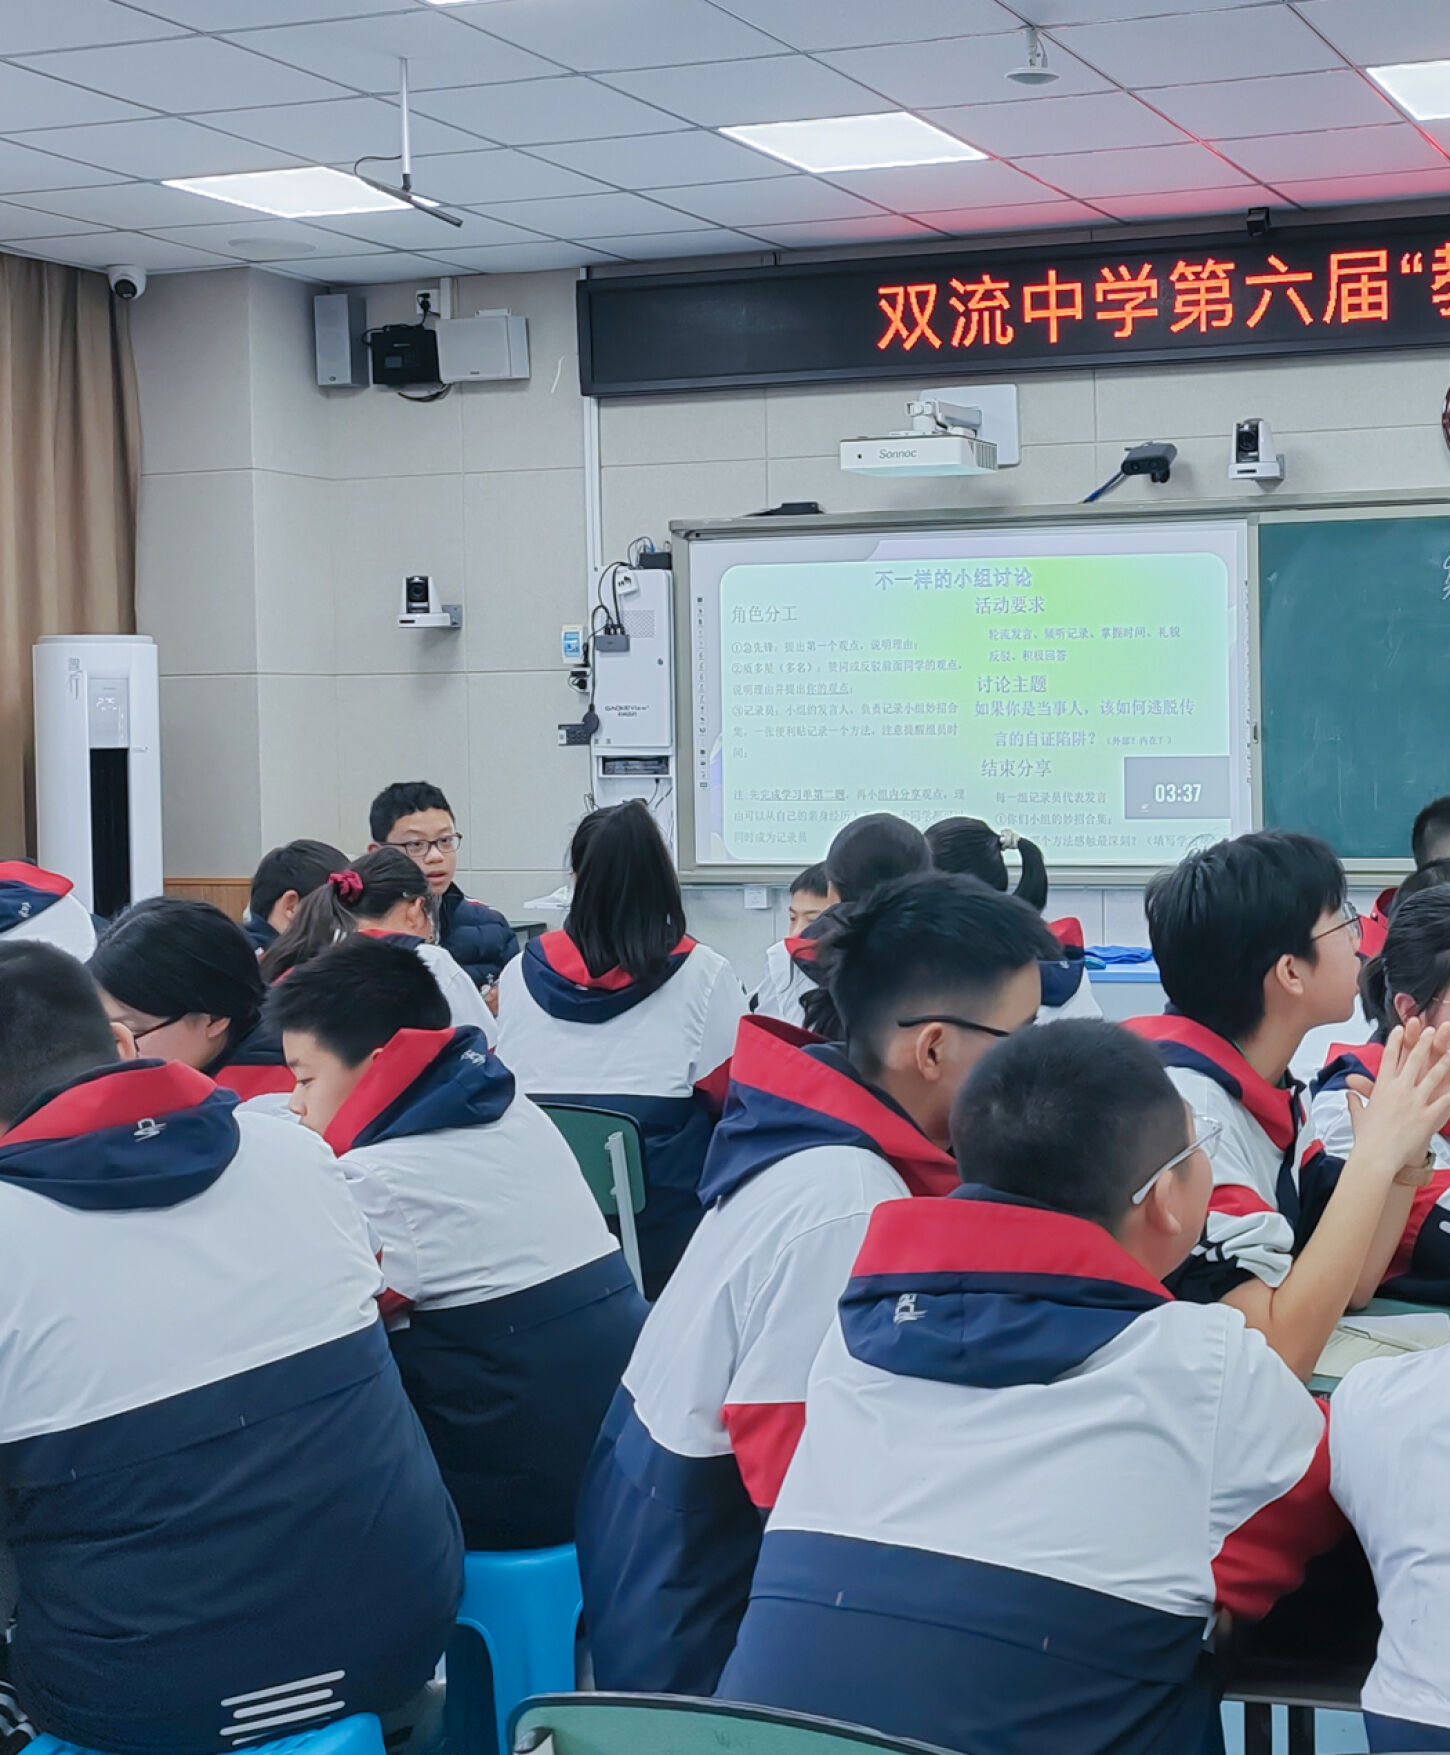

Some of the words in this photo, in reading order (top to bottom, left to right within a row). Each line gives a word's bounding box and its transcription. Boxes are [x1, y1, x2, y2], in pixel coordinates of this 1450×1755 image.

[875, 567, 1032, 591] 不一样的小组讨论
[732, 605, 798, 624] 角色分工
[976, 595, 1045, 615] 活动要求
[977, 675, 1047, 694] 讨论主题
[981, 759, 1052, 778] 结束分享
[1154, 784, 1202, 803] 03:37
